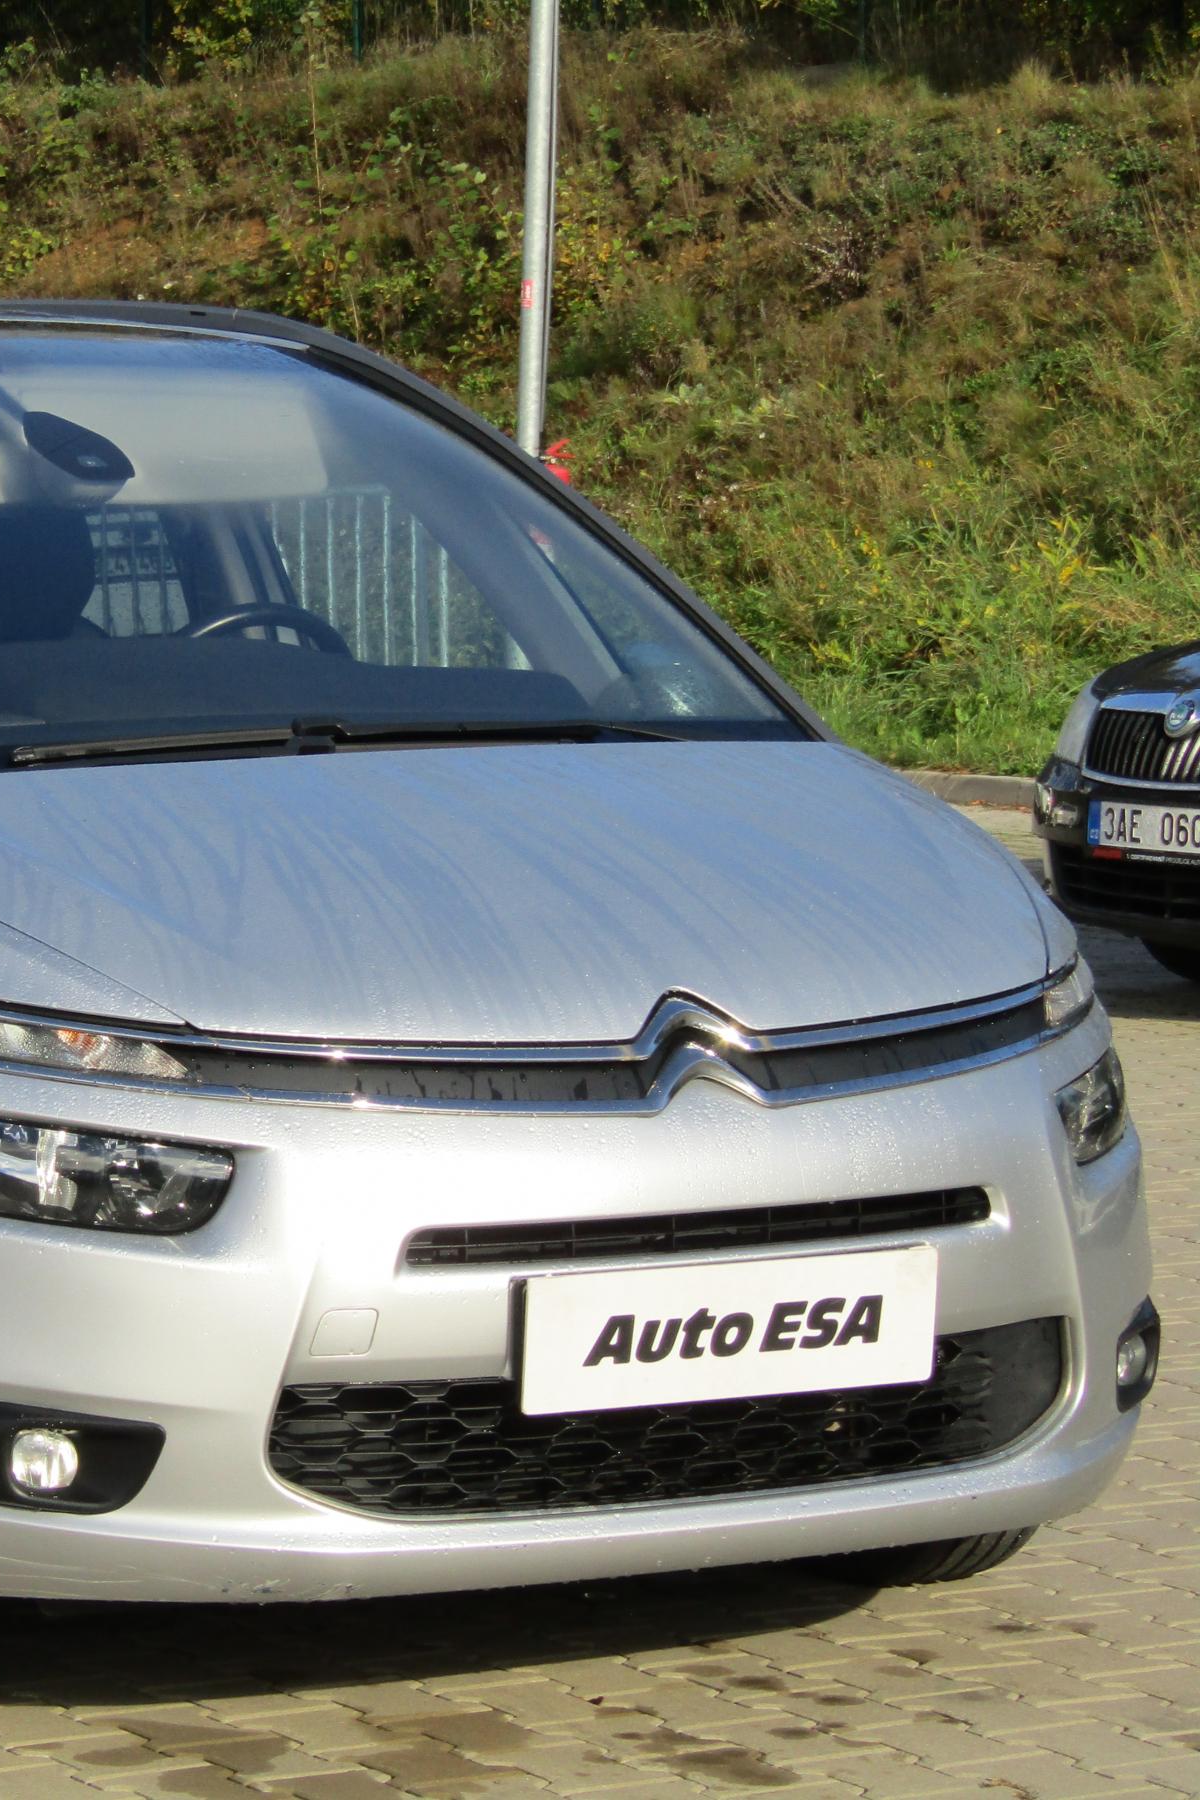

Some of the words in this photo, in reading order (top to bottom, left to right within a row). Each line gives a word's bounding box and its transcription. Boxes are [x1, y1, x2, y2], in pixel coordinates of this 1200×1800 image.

[1104, 807, 1142, 844] 3AE
[582, 1307, 754, 1367] Auto
[759, 1294, 884, 1353] ESA
